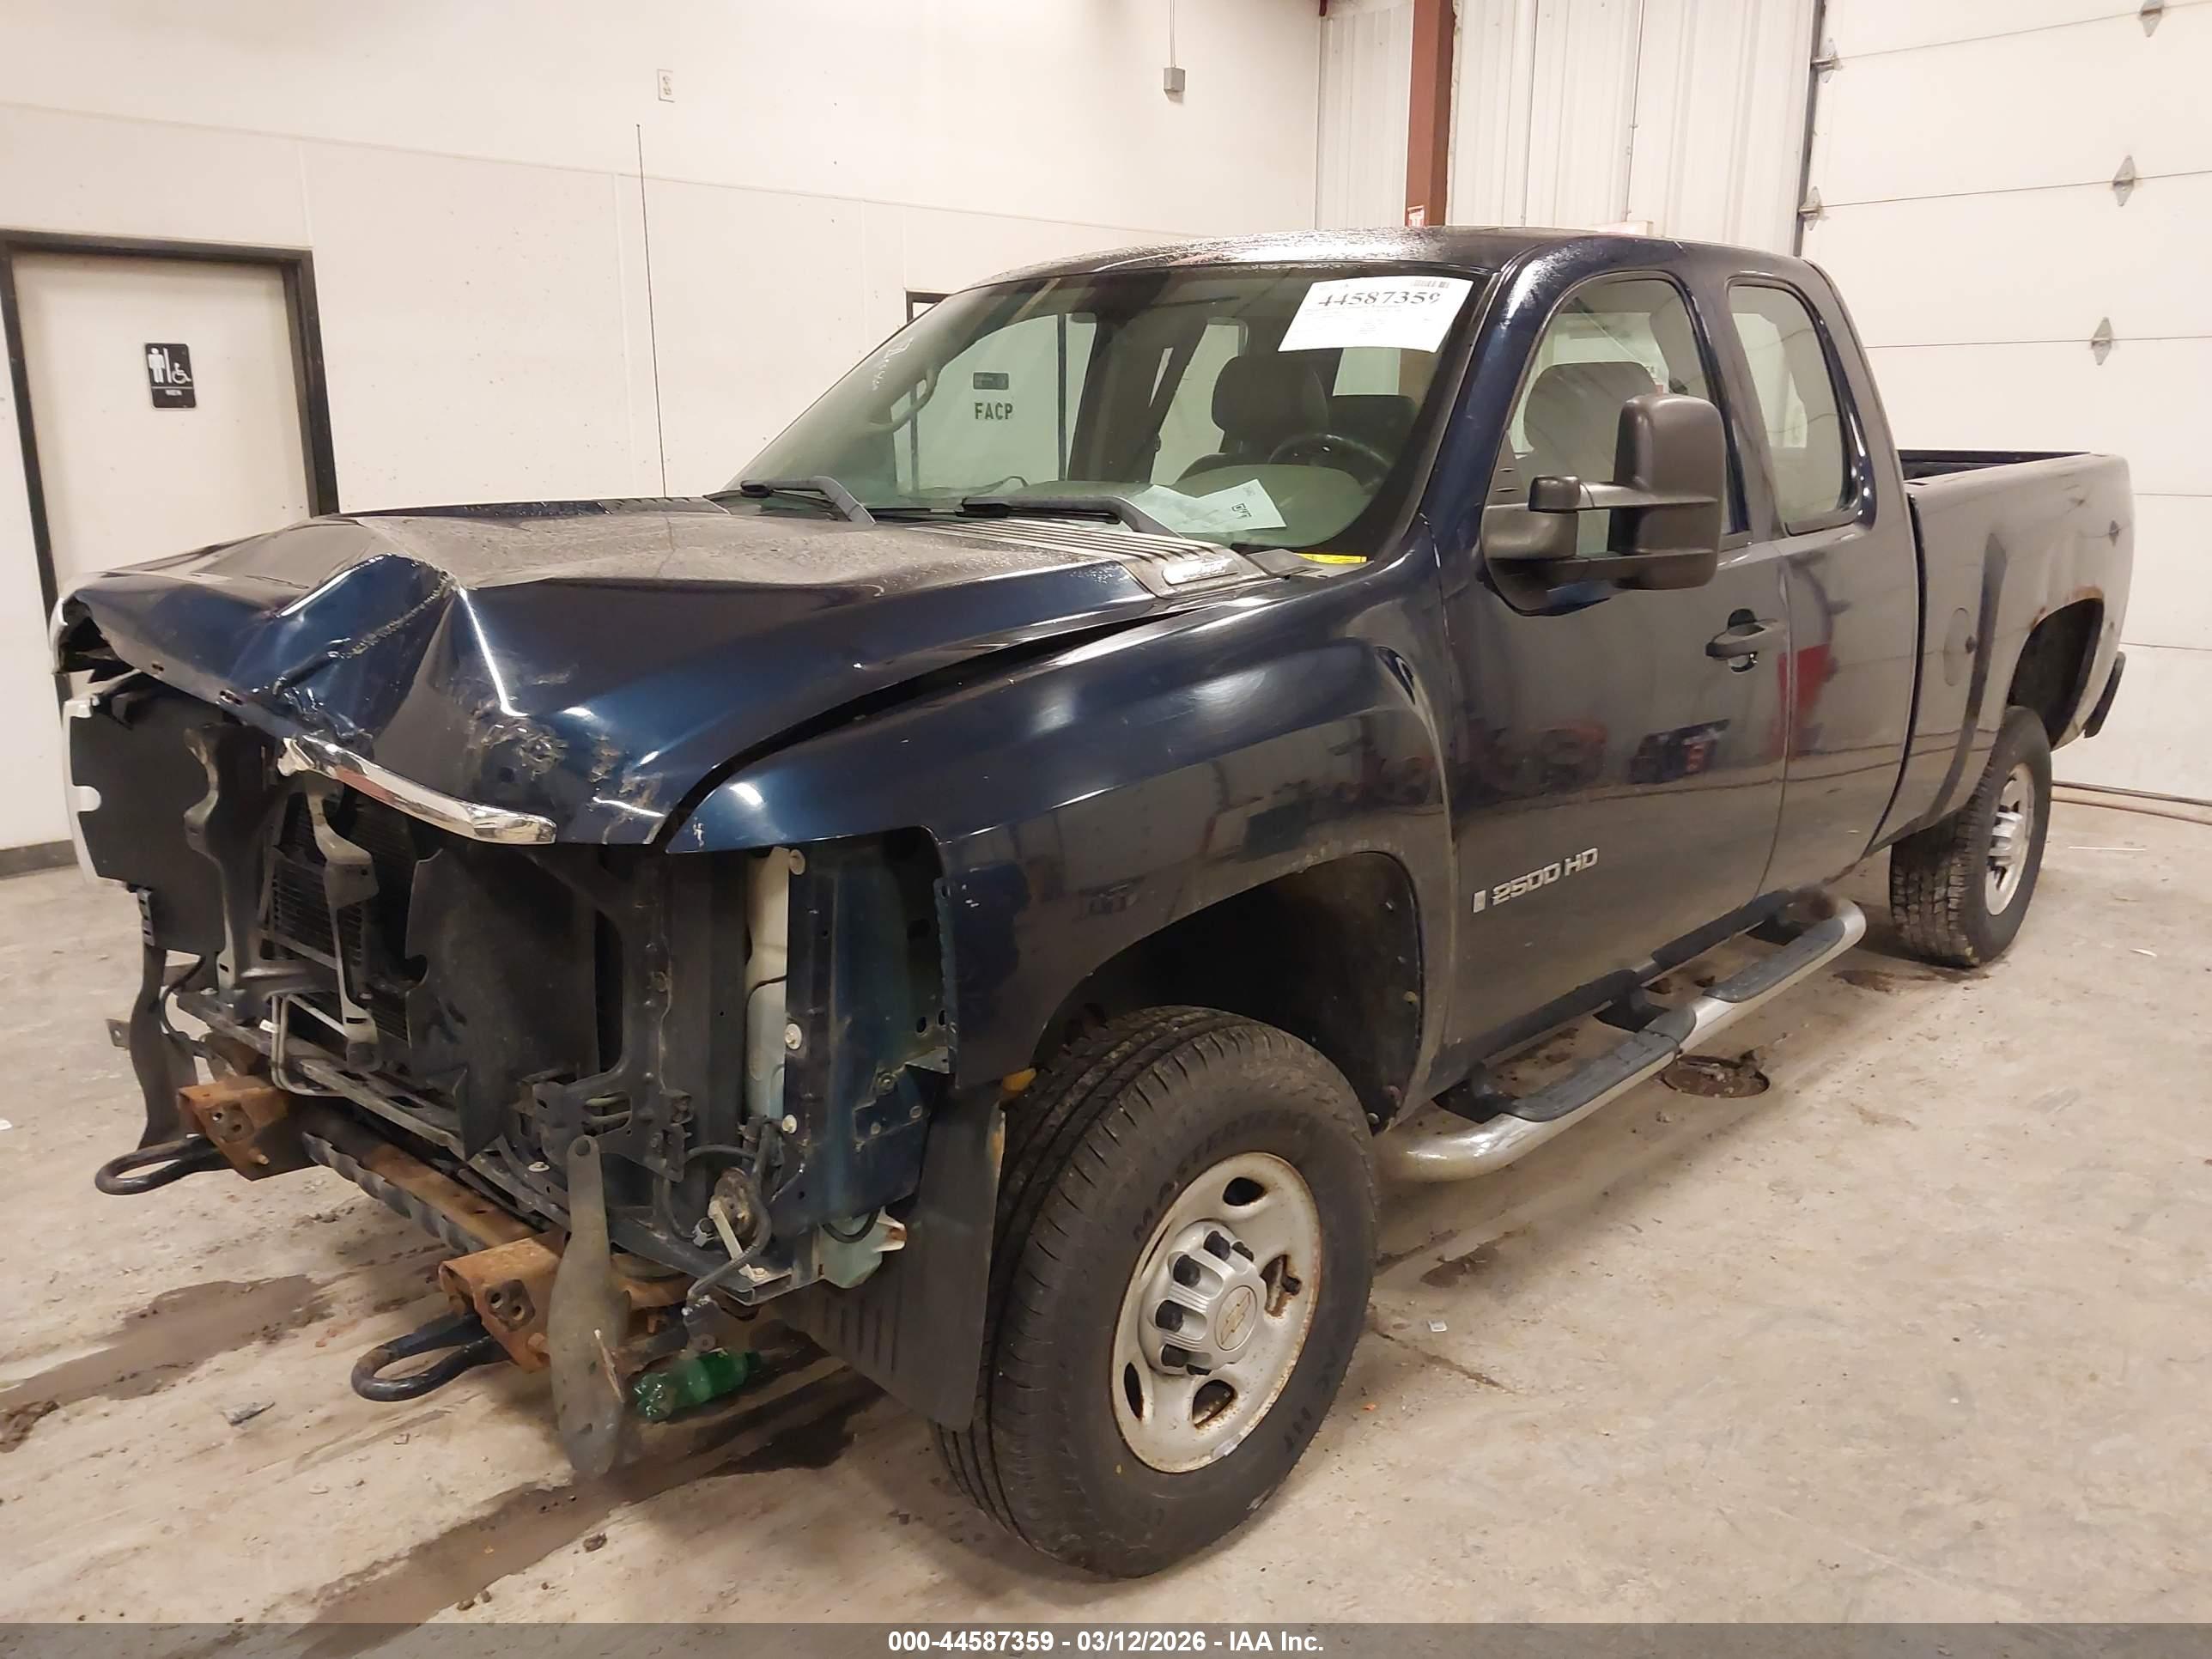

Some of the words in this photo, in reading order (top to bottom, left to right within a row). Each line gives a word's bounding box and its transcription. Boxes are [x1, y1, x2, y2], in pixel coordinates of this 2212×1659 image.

[1318, 290, 1442, 307] 44587359
[975, 402, 1013, 421] FACP
[1492, 862, 1561, 906] 2500
[1564, 847, 1599, 877] HD
